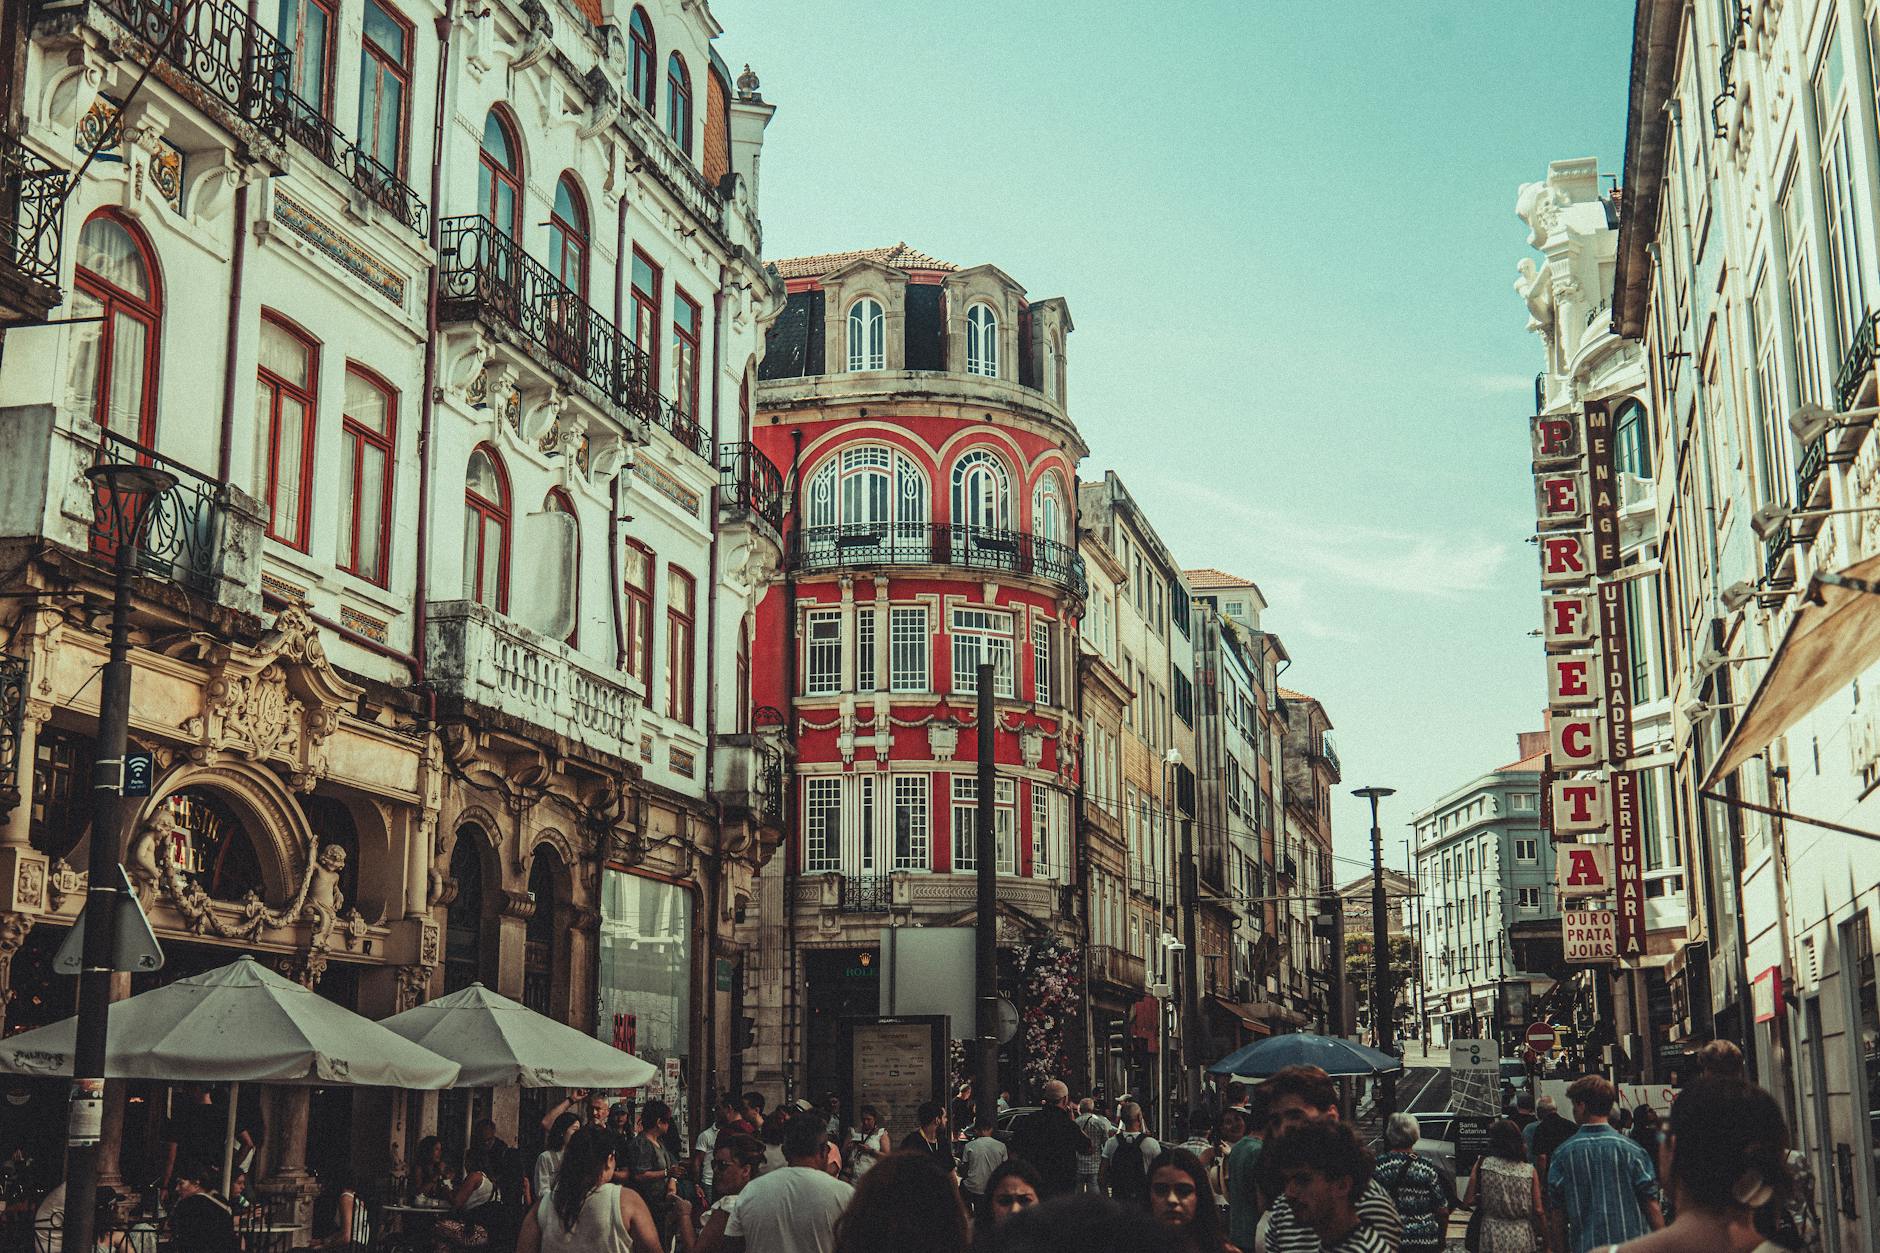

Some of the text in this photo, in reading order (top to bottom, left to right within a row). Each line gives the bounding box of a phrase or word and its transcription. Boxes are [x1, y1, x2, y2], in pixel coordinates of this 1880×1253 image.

[1590, 412, 1614, 560] MENAGE
[1539, 420, 1604, 885] PERFECTA
[1605, 585, 1627, 757] UTILIDADES
[1567, 913, 1611, 925] OURO
[1568, 929, 1612, 941] PRATA
[1618, 776, 1640, 953] PERFUMARIA
[1569, 944, 1613, 956] JOIAS
